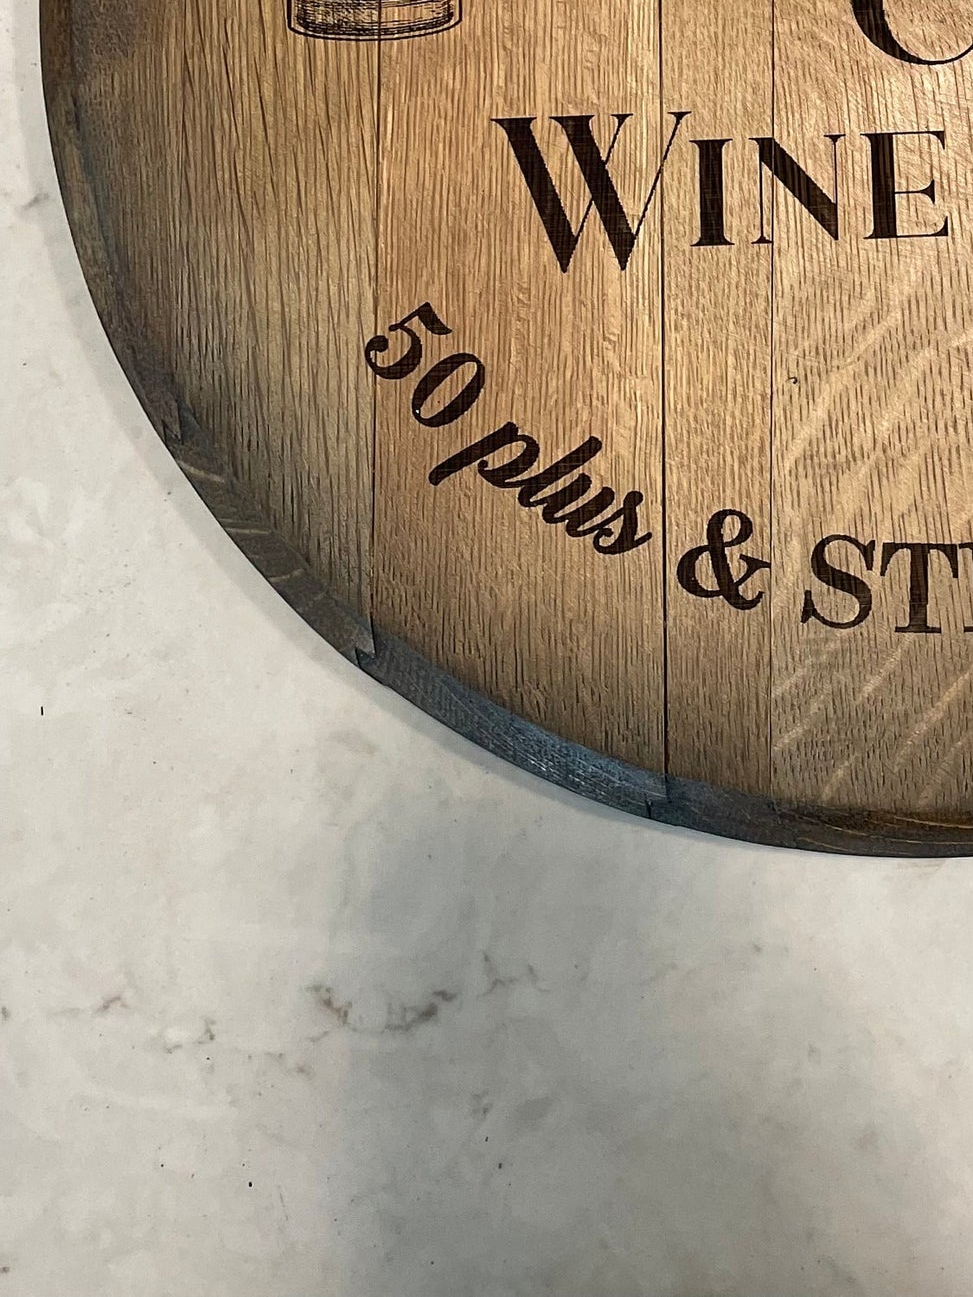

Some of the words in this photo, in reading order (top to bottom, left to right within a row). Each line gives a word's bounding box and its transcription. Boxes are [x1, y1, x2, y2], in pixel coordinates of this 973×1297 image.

[364, 301, 486, 427] 50
[428, 422, 652, 556] plus
[677, 509, 772, 611] &
